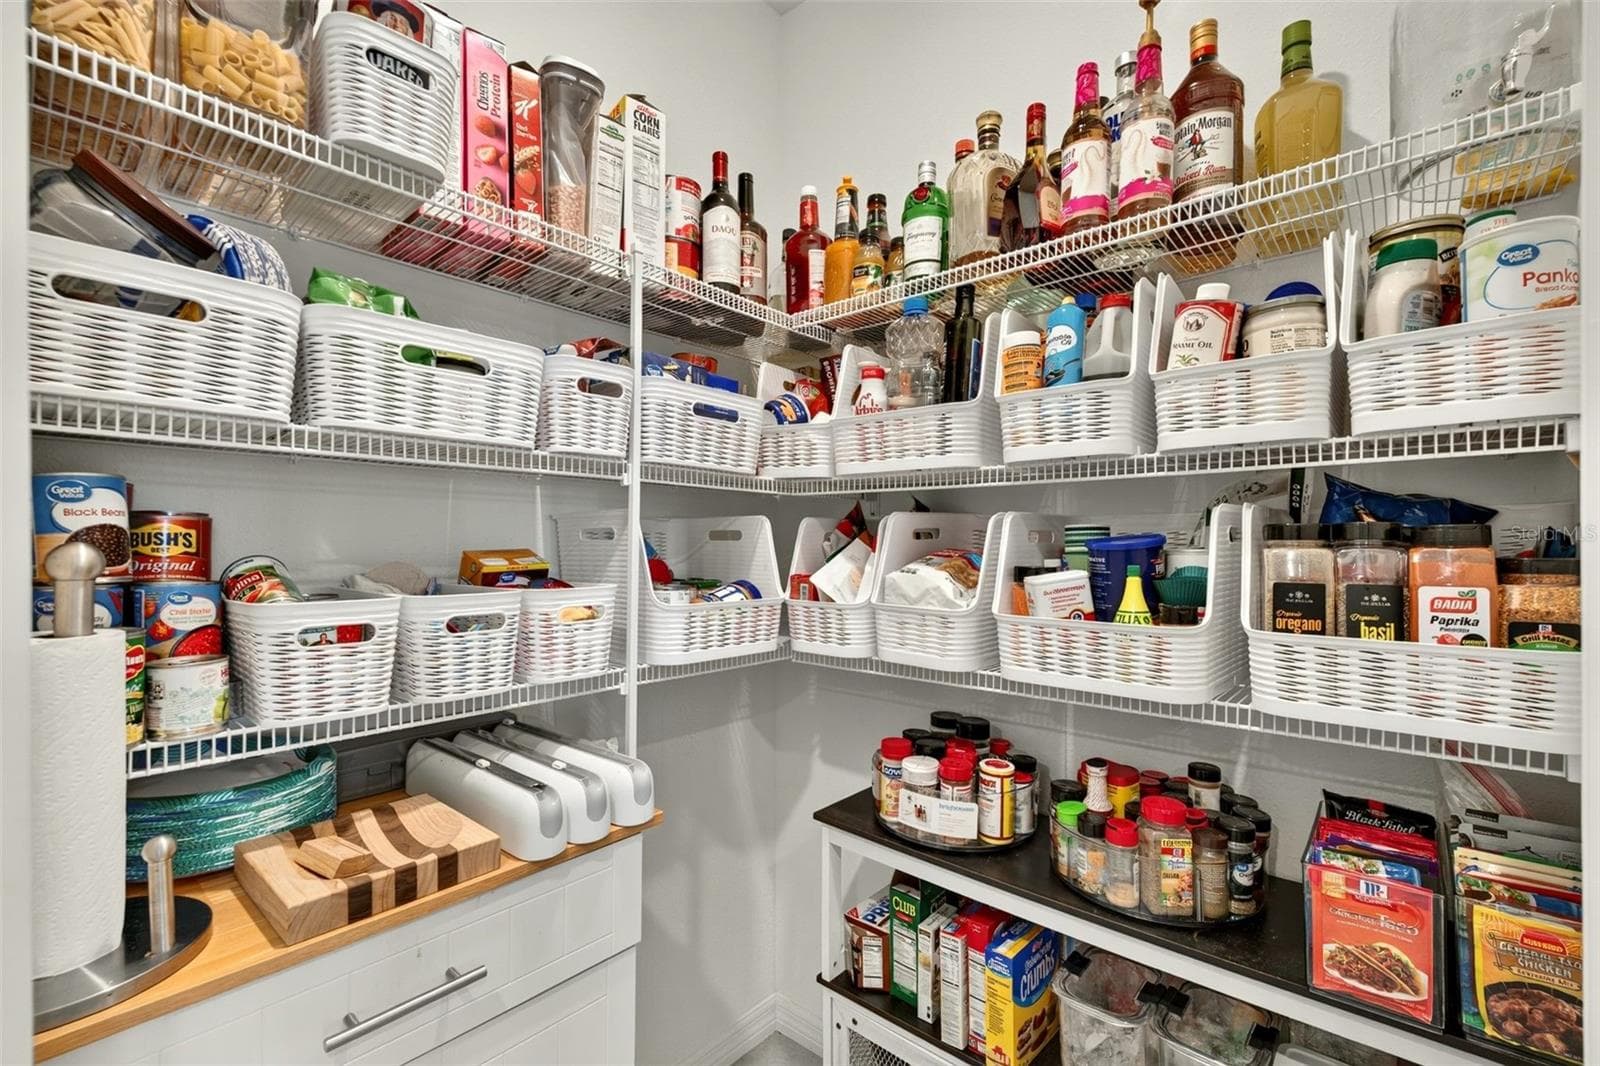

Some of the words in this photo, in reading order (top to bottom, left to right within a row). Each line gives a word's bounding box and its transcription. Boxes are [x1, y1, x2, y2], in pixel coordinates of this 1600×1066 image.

[491, 74, 501, 118] Protein
[633, 109, 660, 130] CORN
[634, 120, 661, 140] FLAKES
[1175, 122, 1196, 142] ptain
[1199, 116, 1233, 130] Morgan
[1501, 246, 1534, 261] Great
[1523, 268, 1579, 287] Panko
[1197, 341, 1214, 349] OIL
[51, 484, 85, 496] Great
[63, 508, 99, 517] Black
[101, 508, 126, 517] Beans
[131, 531, 194, 549] BUSH'S
[130, 559, 196, 573] Original
[1433, 598, 1473, 610] BADIA
[1275, 617, 1322, 633] oregano
[1430, 615, 1480, 628] Paprika
[1360, 622, 1395, 641] basil
[1521, 633, 1541, 643] Grill
[1345, 810, 1381, 827] Black
[892, 896, 916, 917] CLUB
[1378, 912, 1419, 936] Taco
[1019, 949, 1056, 1002] Crumbs
[1518, 956, 1572, 978] CHICKEN
